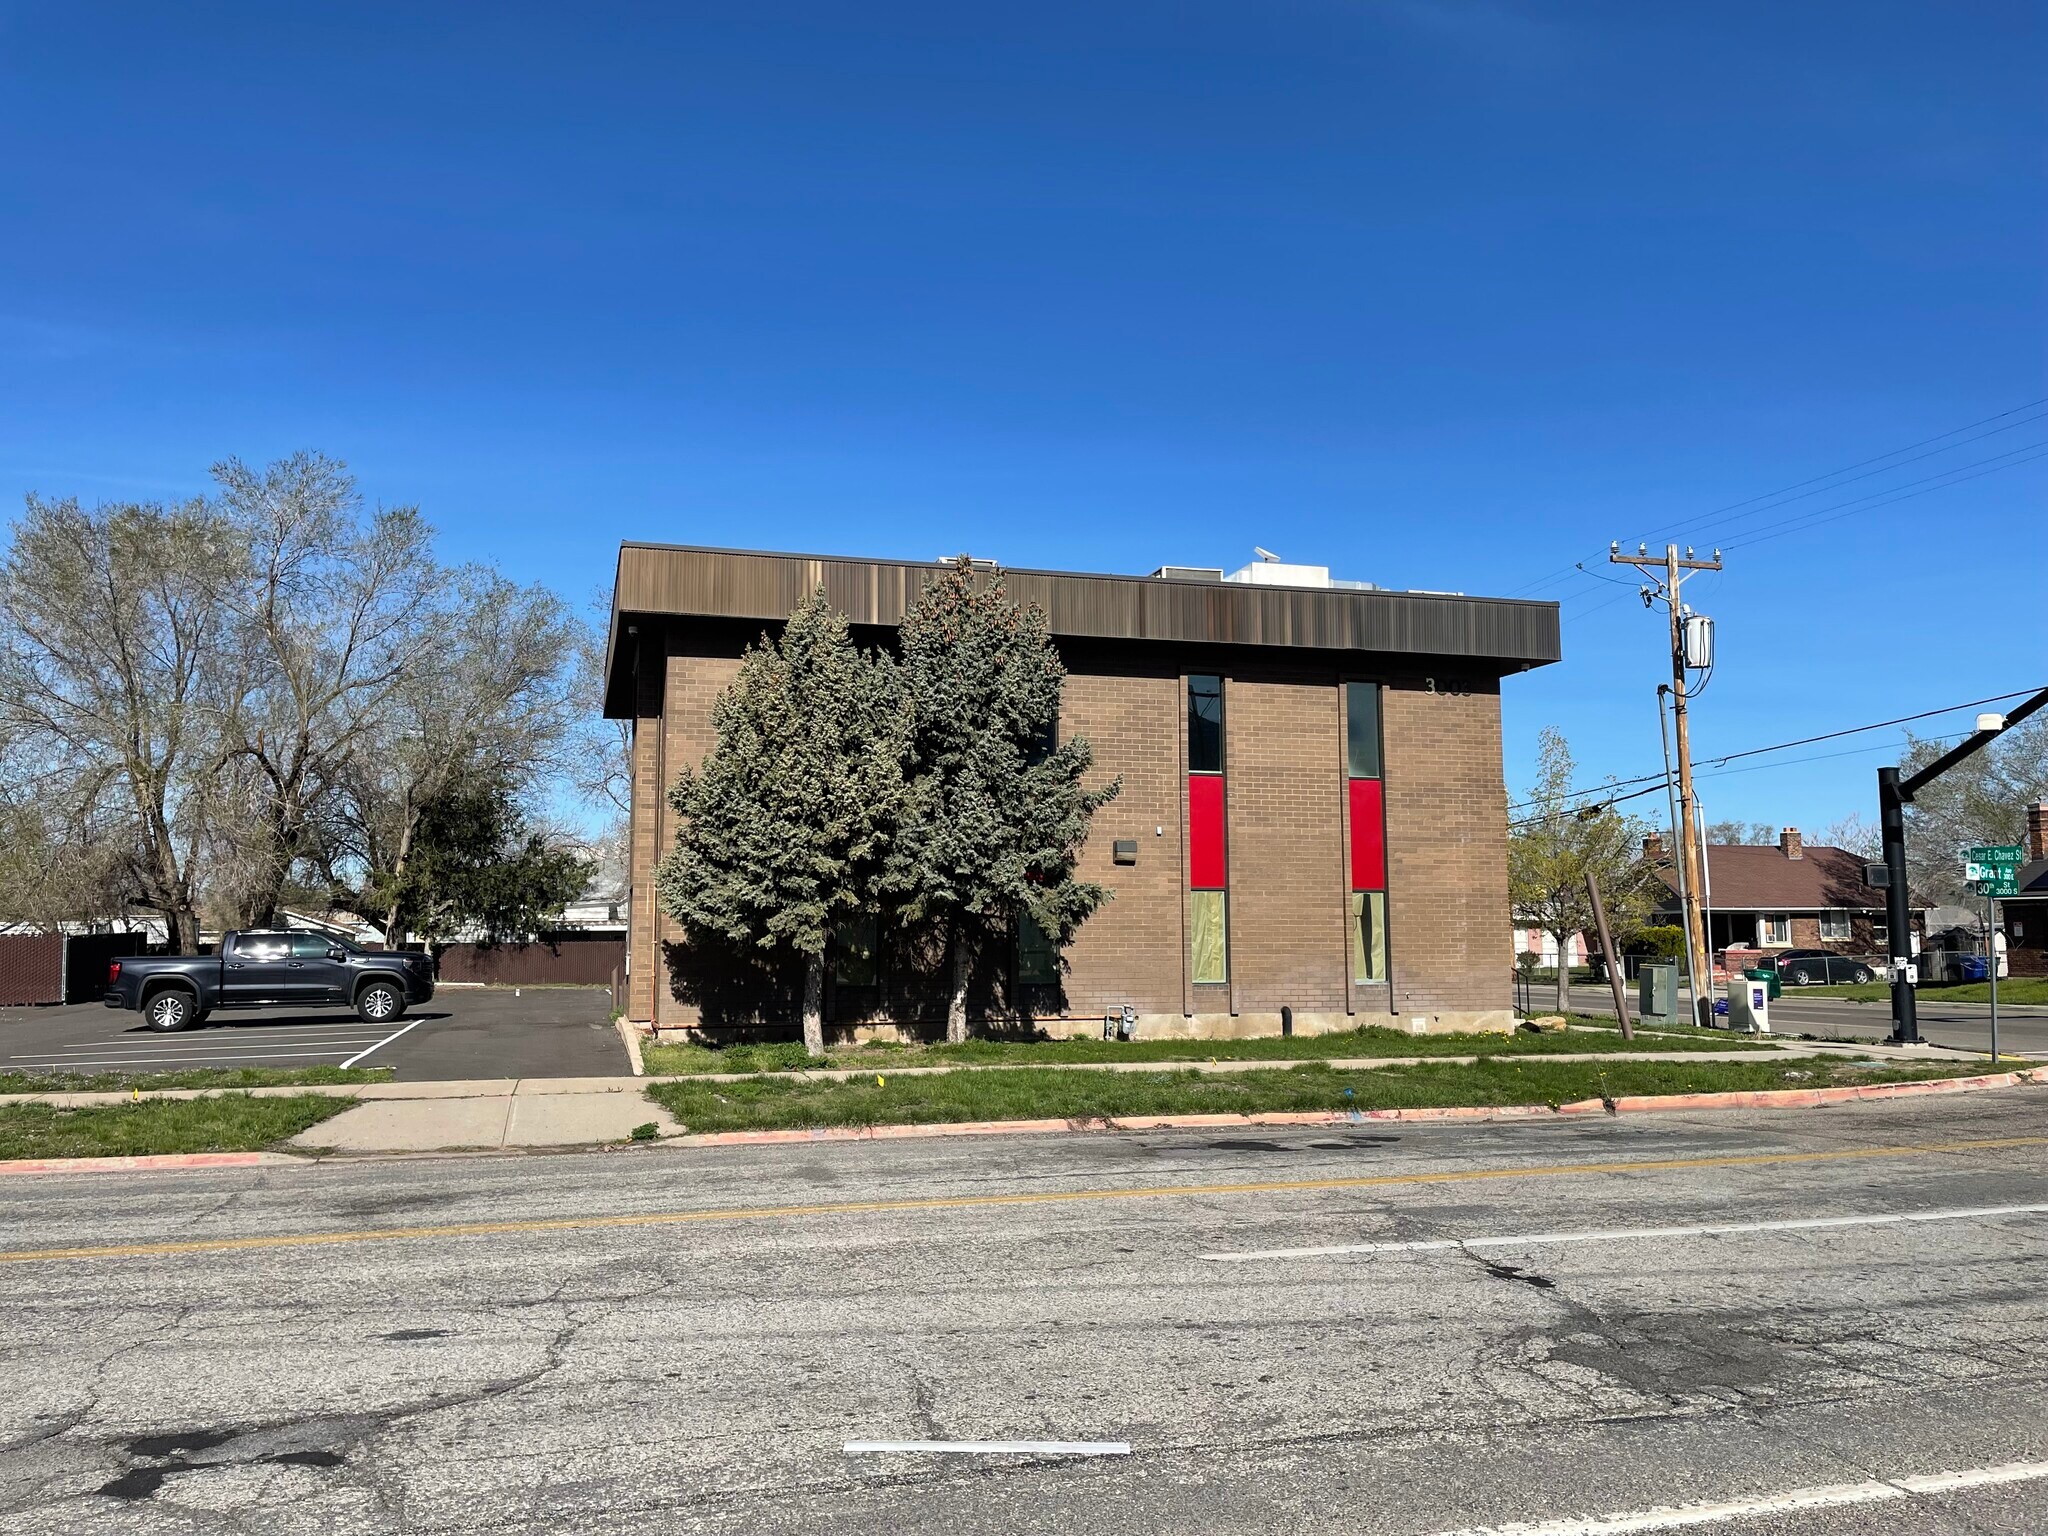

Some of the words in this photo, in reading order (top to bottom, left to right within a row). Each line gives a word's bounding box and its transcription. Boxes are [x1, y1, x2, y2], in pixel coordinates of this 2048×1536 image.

[1972, 850, 1986, 861] Cesar
[1994, 849, 2014, 861] Chavez
[2015, 849, 2022, 861] St
[1977, 882, 1995, 894] 30th
